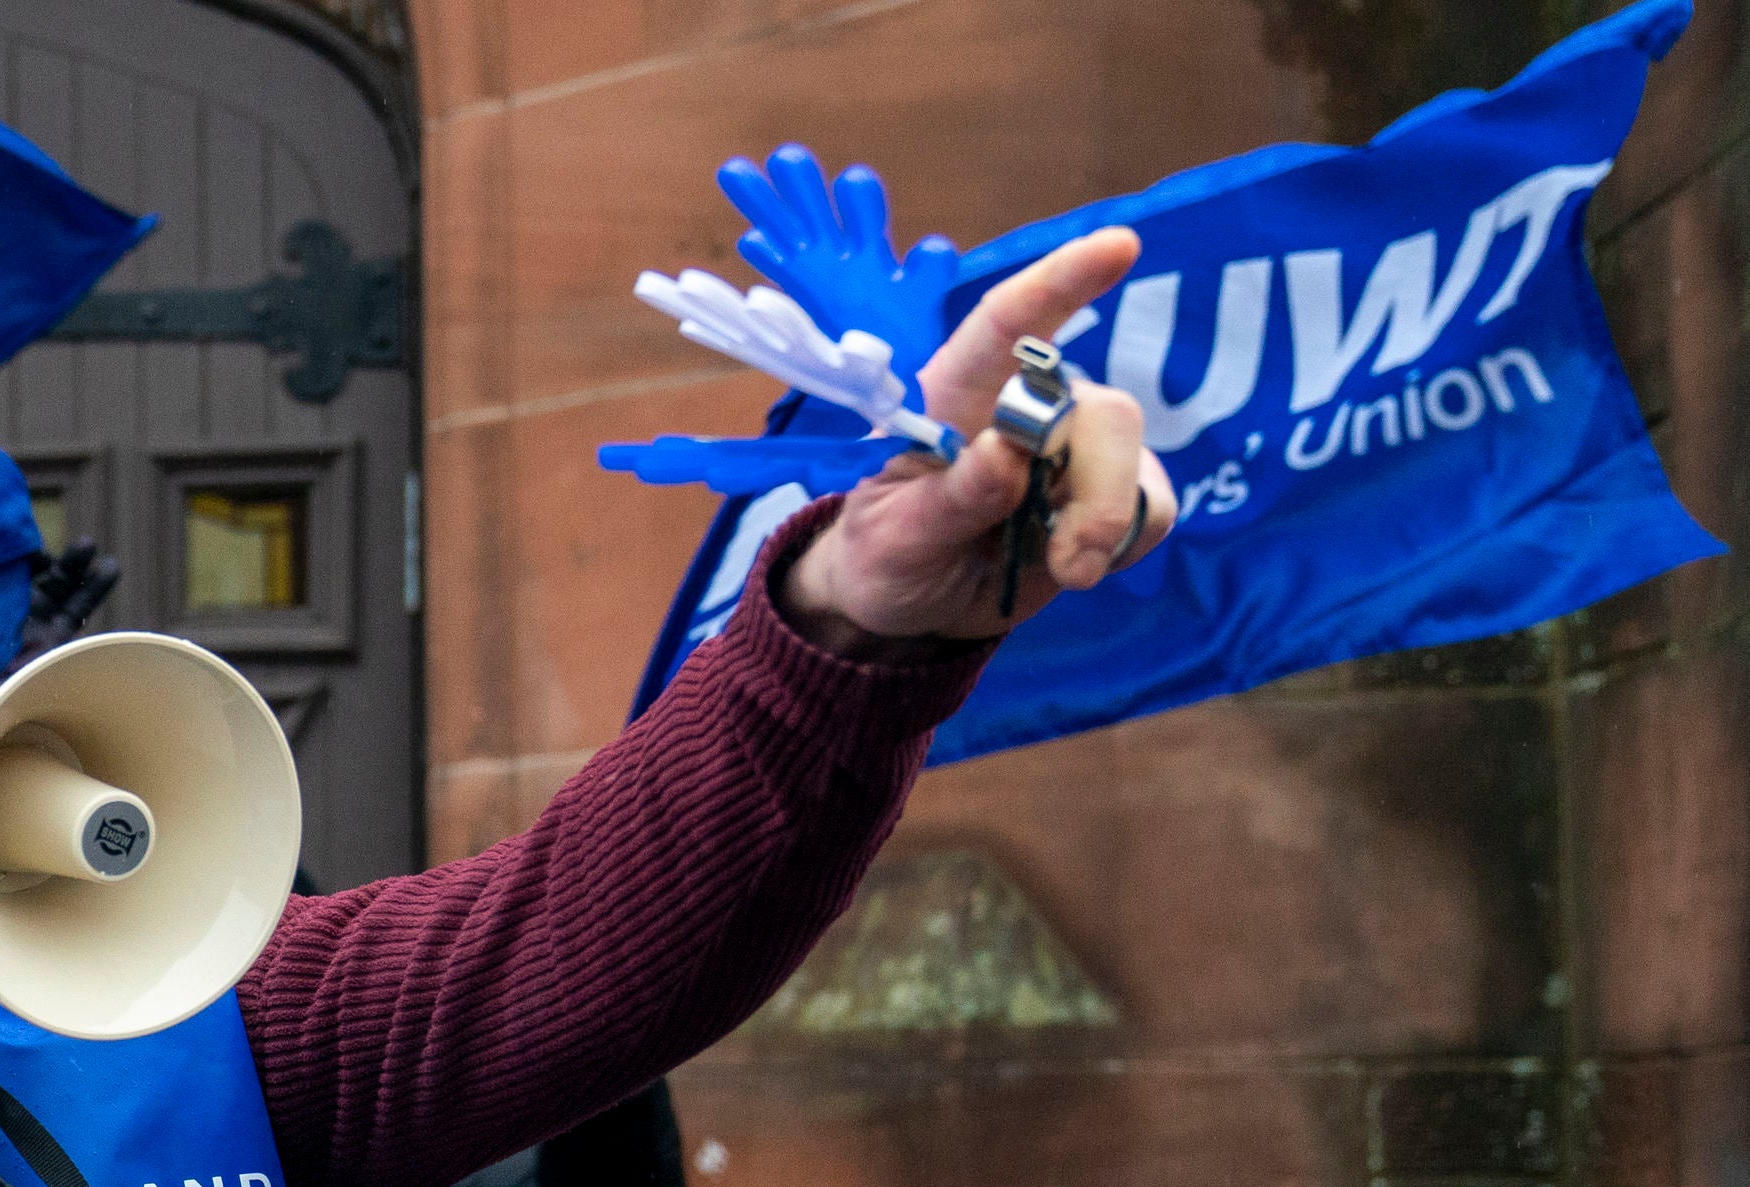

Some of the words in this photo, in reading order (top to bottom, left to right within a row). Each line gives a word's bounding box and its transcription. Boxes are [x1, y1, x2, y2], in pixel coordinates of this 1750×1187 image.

[1053, 158, 1614, 452] UWT
[1284, 346, 1554, 472] Union
[100, 825, 132, 849] SHOW
